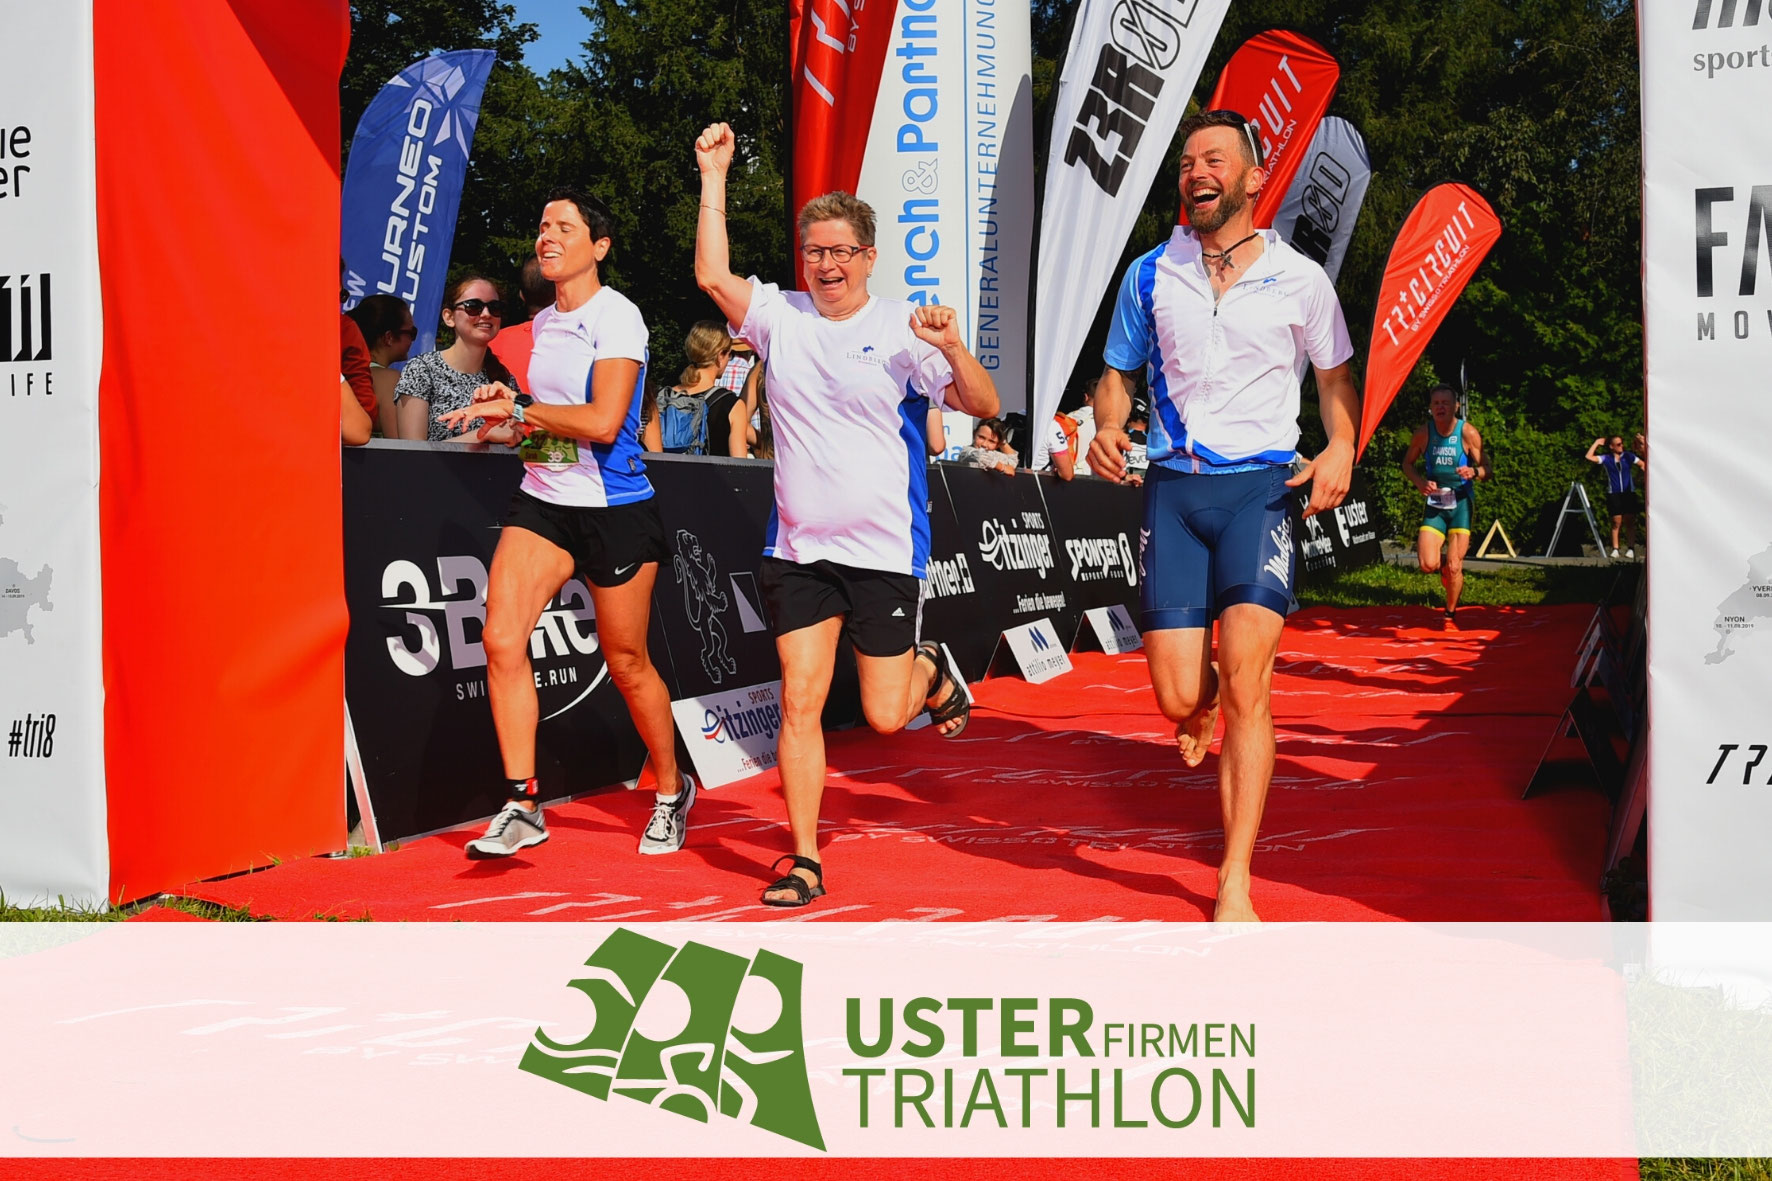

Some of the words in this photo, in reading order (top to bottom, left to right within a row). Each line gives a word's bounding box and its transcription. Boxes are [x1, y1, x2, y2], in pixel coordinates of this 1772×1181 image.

[1693, 44, 1772, 79] sport
[402, 154, 442, 316] USTOM
[1695, 185, 1772, 298] FA
[1697, 310, 1772, 341] MO
[1435, 457, 1454, 466] AUS
[8, 713, 57, 758] #tri8
[1062, 838, 1305, 852] TRIATHON
